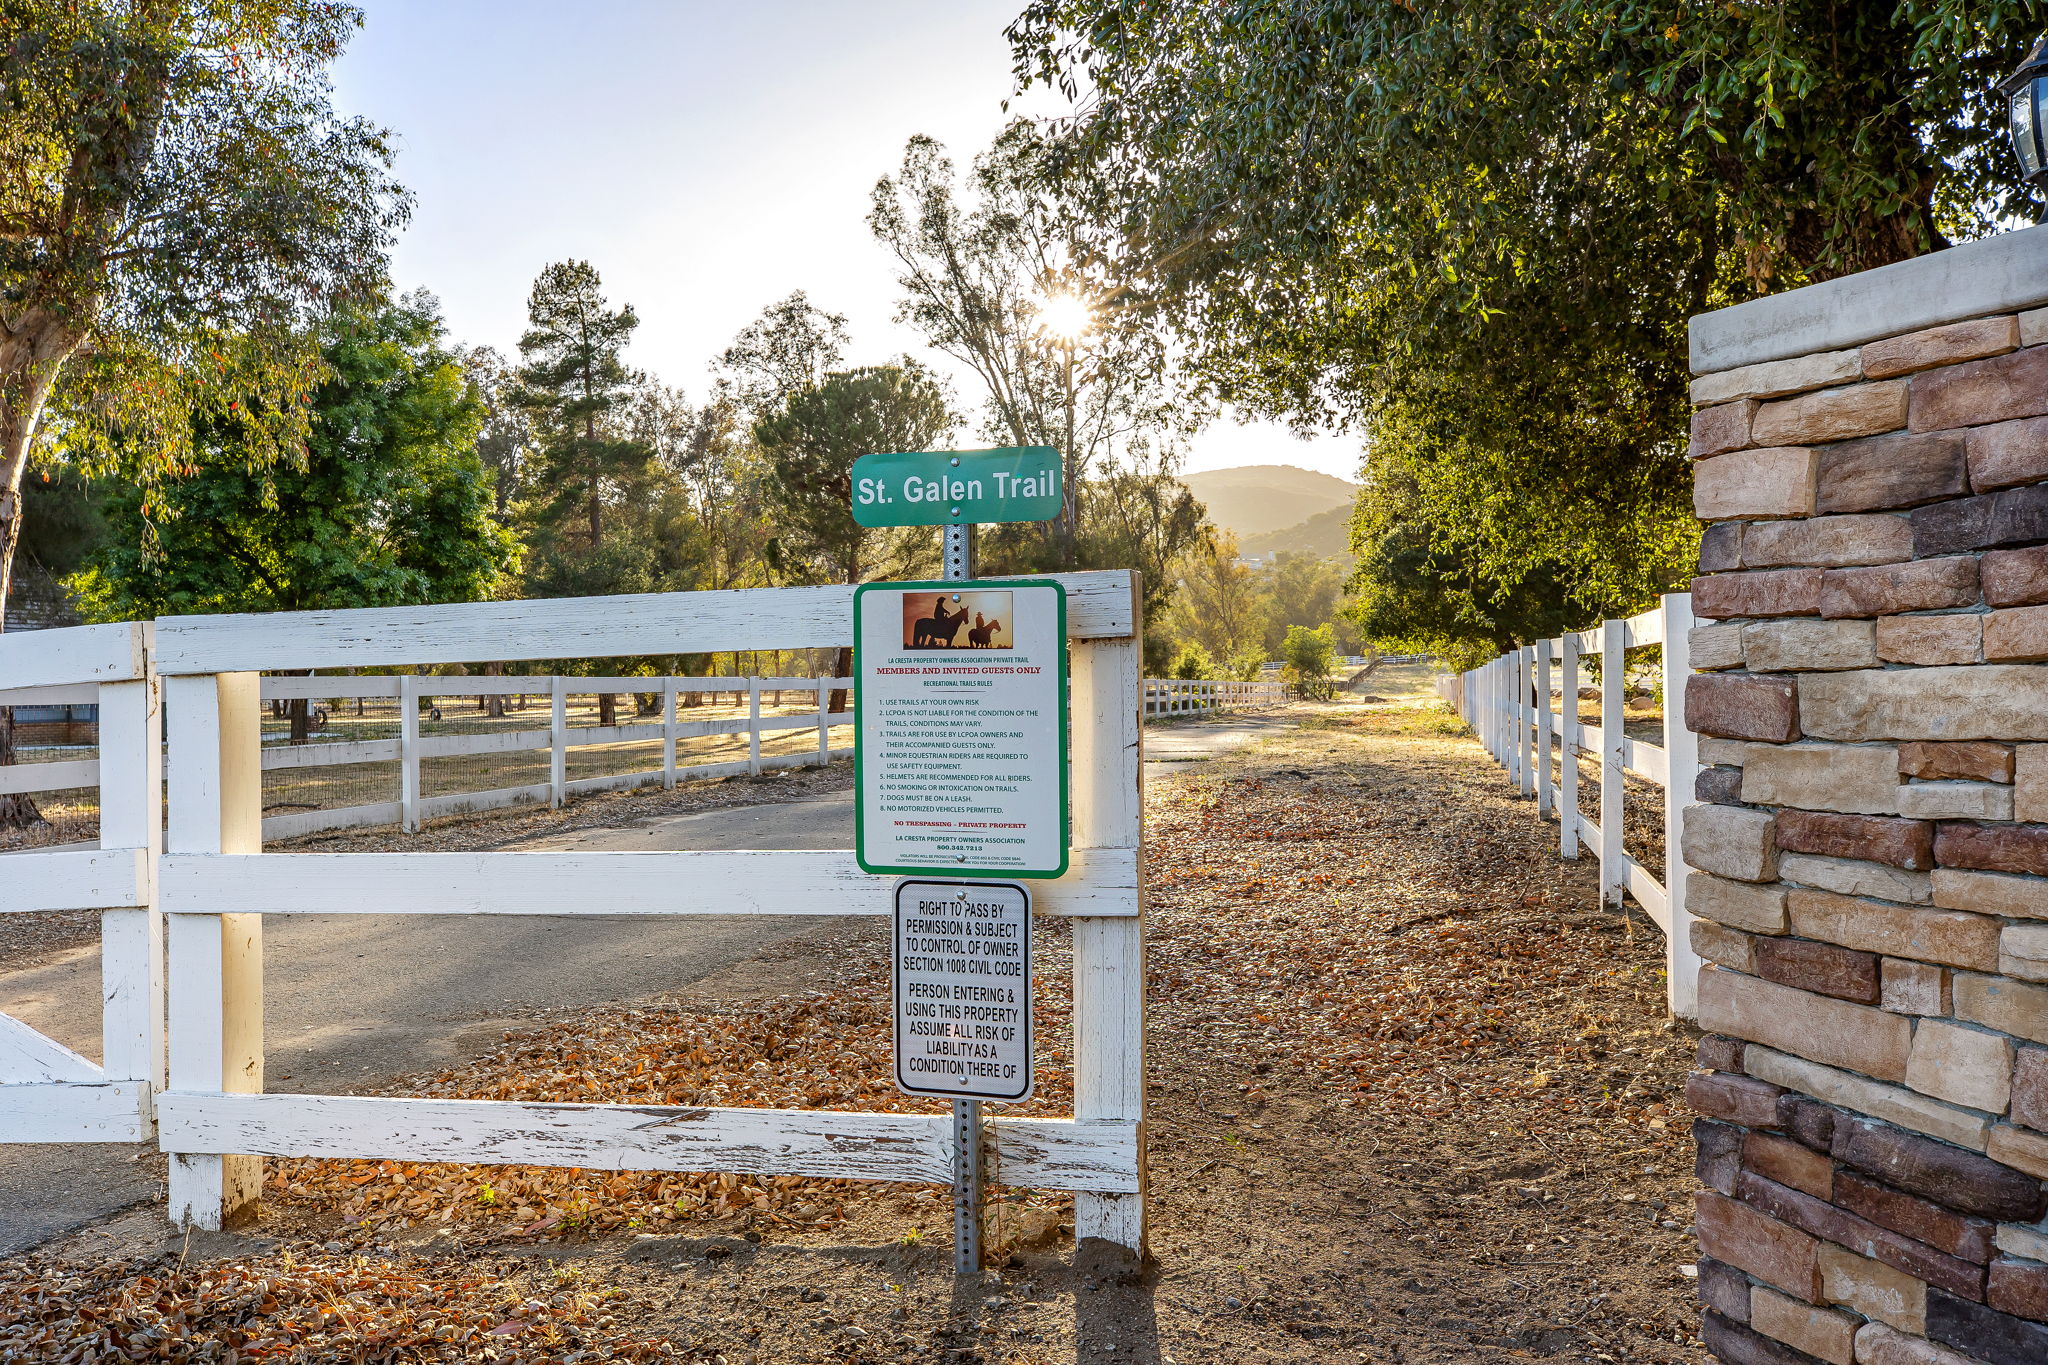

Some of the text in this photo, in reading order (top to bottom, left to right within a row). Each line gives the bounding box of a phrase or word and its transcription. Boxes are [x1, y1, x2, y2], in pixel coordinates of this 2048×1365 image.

[858, 470, 1054, 504] St. Galen Trail
[920, 901, 1004, 918] RIGHT TO PASS BY
[906, 919, 1017, 938] PERMISSION & SUBJECT
[906, 937, 1018, 956] TO CONTROL OF OWNER
[904, 957, 1021, 976] SECTION 1008 CIVIL CODE
[909, 983, 1014, 1003] PERSON ENTERING &
[906, 1002, 1018, 1023] USING THIS PROPERTY
[910, 1021, 1015, 1041] ASSUME ALL RISK OF
[927, 1040, 997, 1058] LIABILITY AS A
[910, 1058, 1016, 1078] CONDITION THERE OF
